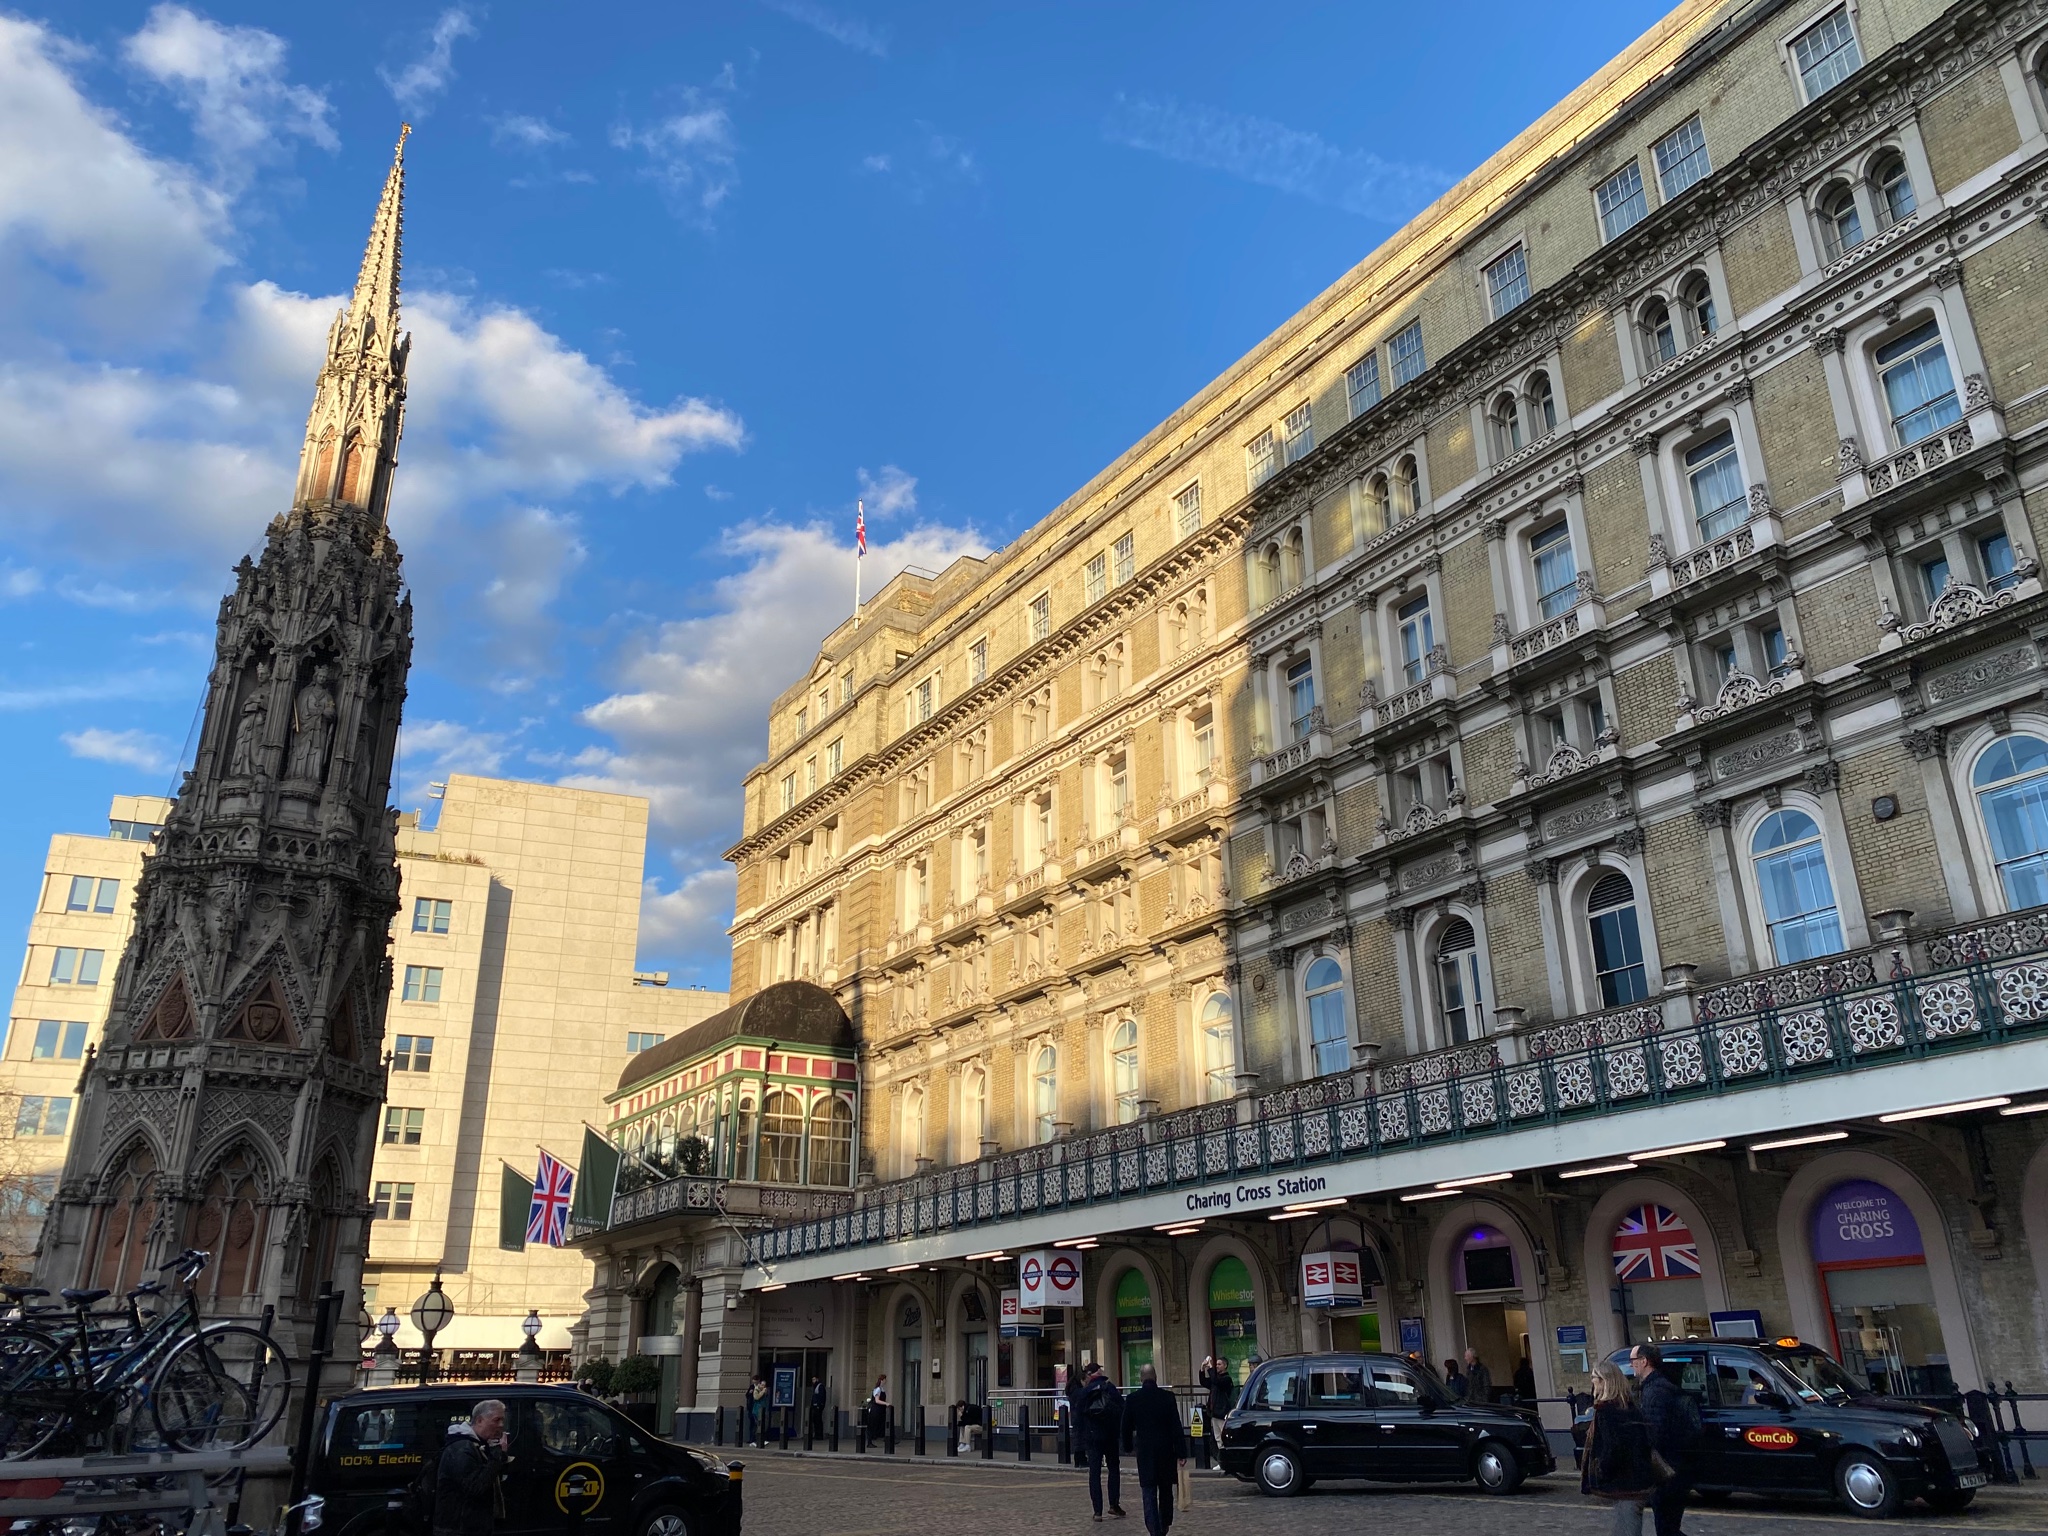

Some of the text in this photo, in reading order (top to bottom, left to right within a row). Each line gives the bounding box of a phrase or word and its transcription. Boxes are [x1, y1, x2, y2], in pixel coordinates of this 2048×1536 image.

[1186, 1176, 1326, 1210] Charing Cross Station
[1835, 1198, 1887, 1210] WELCOME TO
[1837, 1209, 1890, 1224] CHARING
[1840, 1222, 1894, 1240] CROSS
[1119, 1296, 1151, 1307] Whistlesto
[1748, 1432, 1794, 1443] ComCab
[340, 1453, 422, 1466] 100% Electric
